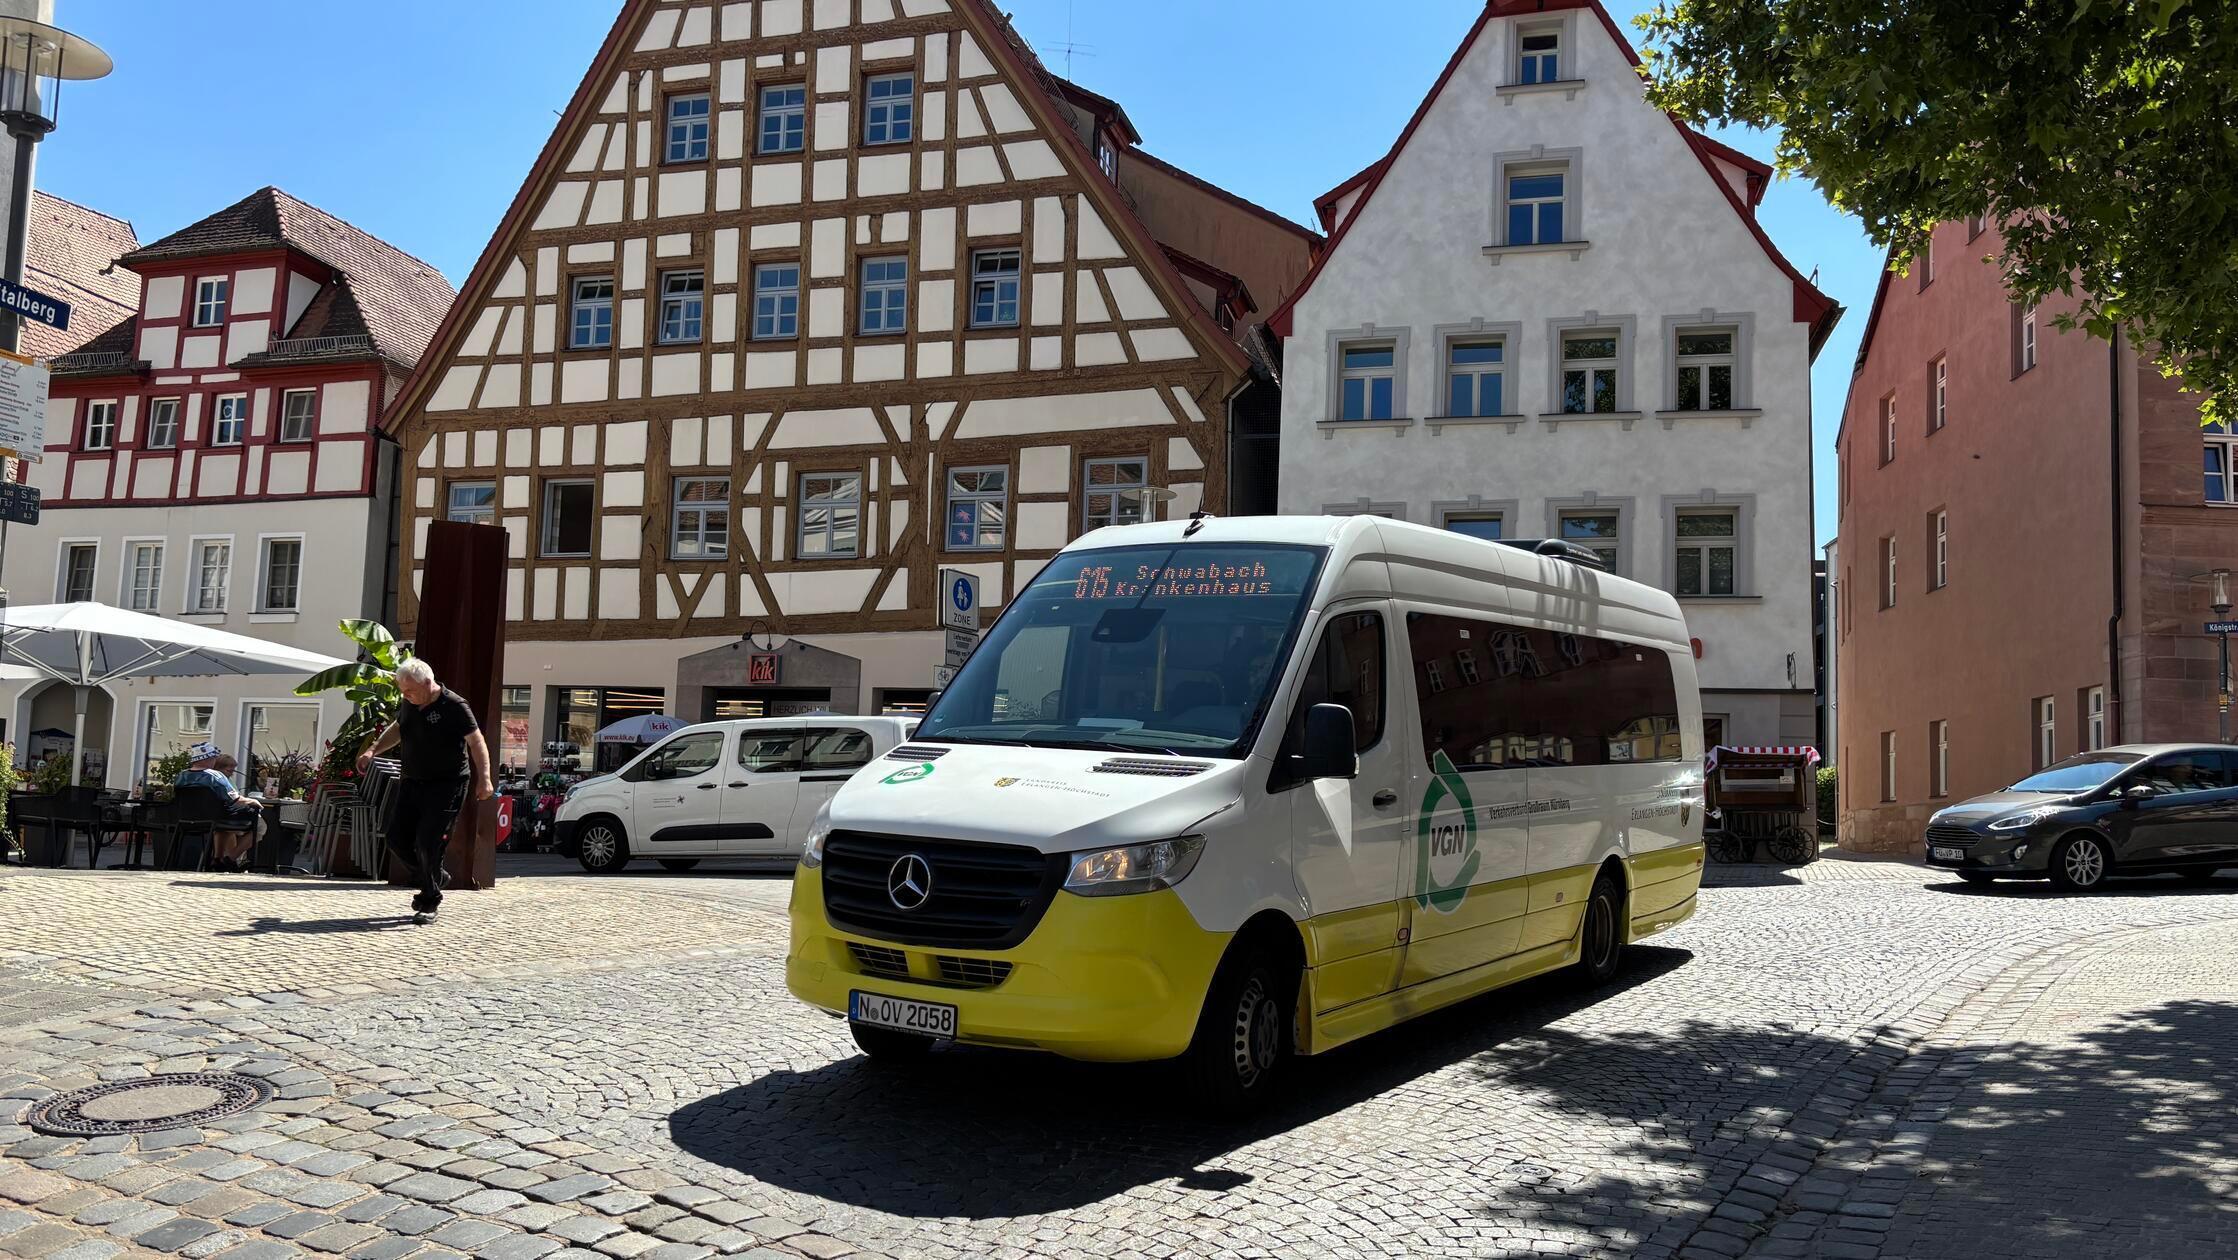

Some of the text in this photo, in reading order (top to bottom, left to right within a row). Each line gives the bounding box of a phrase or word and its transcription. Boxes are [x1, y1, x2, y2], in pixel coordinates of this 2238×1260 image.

[0, 285, 56, 324] talberg
[21, 490, 40, 502] S 100
[1137, 562, 1266, 580] Schwabach
[953, 612, 971, 625] ZONE
[751, 657, 773, 681] kik
[652, 721, 670, 731] kik
[1431, 824, 1465, 857] VGN
[860, 996, 870, 1019] N
[881, 1000, 903, 1023] OV
[906, 1004, 952, 1032] 2058
